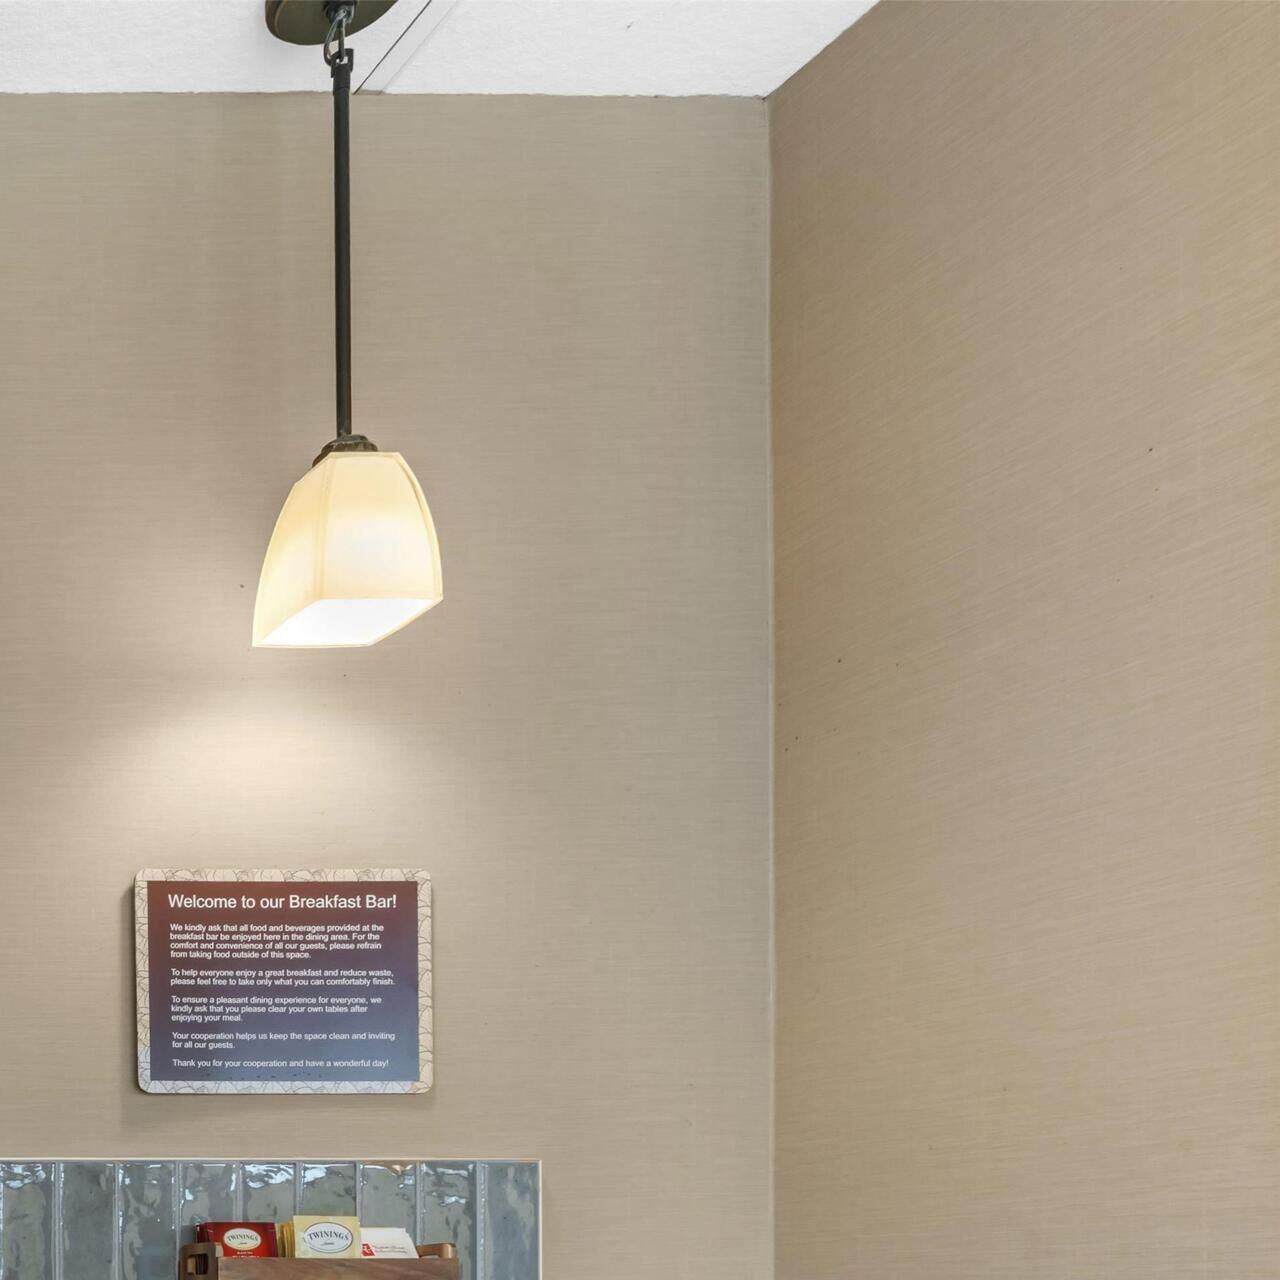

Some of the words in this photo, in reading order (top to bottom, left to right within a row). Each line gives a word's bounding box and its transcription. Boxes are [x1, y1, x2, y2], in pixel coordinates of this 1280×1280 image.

[168, 894, 237, 909] Welcome
[241, 894, 256, 909] to
[259, 897, 285, 909] our
[289, 894, 361, 909] Breakfast
[365, 894, 397, 909] Bar!
[184, 924, 206, 933] kindly
[284, 924, 325, 933] beverages
[326, 924, 360, 933] provided
[231, 933, 262, 942] enjoyed
[305, 933, 329, 942] dining
[170, 942, 198, 950] comfort
[200, 942, 214, 950] and
[215, 942, 263, 950] convenience
[264, 942, 273, 950] of
[274, 942, 283, 950] all
[299, 942, 328, 950] guests,
[329, 942, 355, 950] please
[356, 942, 382, 950] refrain
[170, 950, 188, 958] from
[189, 950, 212, 960] taking
[213, 950, 230, 958] food
[231, 950, 259, 958] outside
[260, 950, 269, 958] of
[270, 950, 284, 958] this
[285, 952, 311, 960] space.
[181, 969, 198, 978] help
[199, 970, 234, 978] everyone
[235, 969, 256, 978] enjoy
[264, 969, 285, 978] great
[368, 969, 394, 978] waste,
[170, 977, 195, 986] please
[196, 977, 211, 985] feel
[212, 977, 227, 985] free
[228, 977, 236, 985] to
[238, 977, 255, 985] take
[256, 977, 272, 986] only
[273, 977, 292, 985] what
[326, 977, 371, 986] comfortably
[372, 977, 396, 985] finish.
[171, 996, 181, 1004] To
[216, 996, 248, 1005] pleasant
[249, 996, 273, 1005] dining
[274, 996, 317, 1005] experience
[318, 996, 329, 1004] for
[330, 997, 368, 1005] everyone,
[171, 1005, 193, 1014] kindly
[194, 1005, 208, 1013] ask
[209, 1005, 224, 1013] that
[225, 1006, 239, 1014] you
[240, 1005, 266, 1014] please
[267, 1005, 287, 1013] clear
[288, 1006, 305, 1014] your
[324, 1005, 349, 1013] tables
[350, 1005, 368, 1013] after
[171, 1014, 203, 1023] enjoying
[204, 1015, 220, 1023] your
[172, 1032, 189, 1040] Your
[190, 1032, 234, 1041] cooperation
[235, 1032, 257, 1041] helps
[269, 1032, 288, 1041] keep
[289, 1032, 302, 1040] the
[328, 1032, 350, 1040] clean
[351, 1032, 366, 1040] and
[367, 1032, 396, 1041] inviting
[172, 1041, 182, 1049] for
[183, 1041, 193, 1049] all
[208, 1041, 235, 1050] guests.
[172, 1059, 196, 1067] Thank
[212, 1059, 223, 1067] for
[242, 1059, 287, 1068] cooperation
[288, 1059, 304, 1067] and
[305, 1059, 324, 1067] have
[332, 1059, 370, 1067] wonderful
[371, 1059, 389, 1068] day!
[227, 1232, 259, 1242] TWININGS
[307, 1231, 350, 1241] TWININGS
